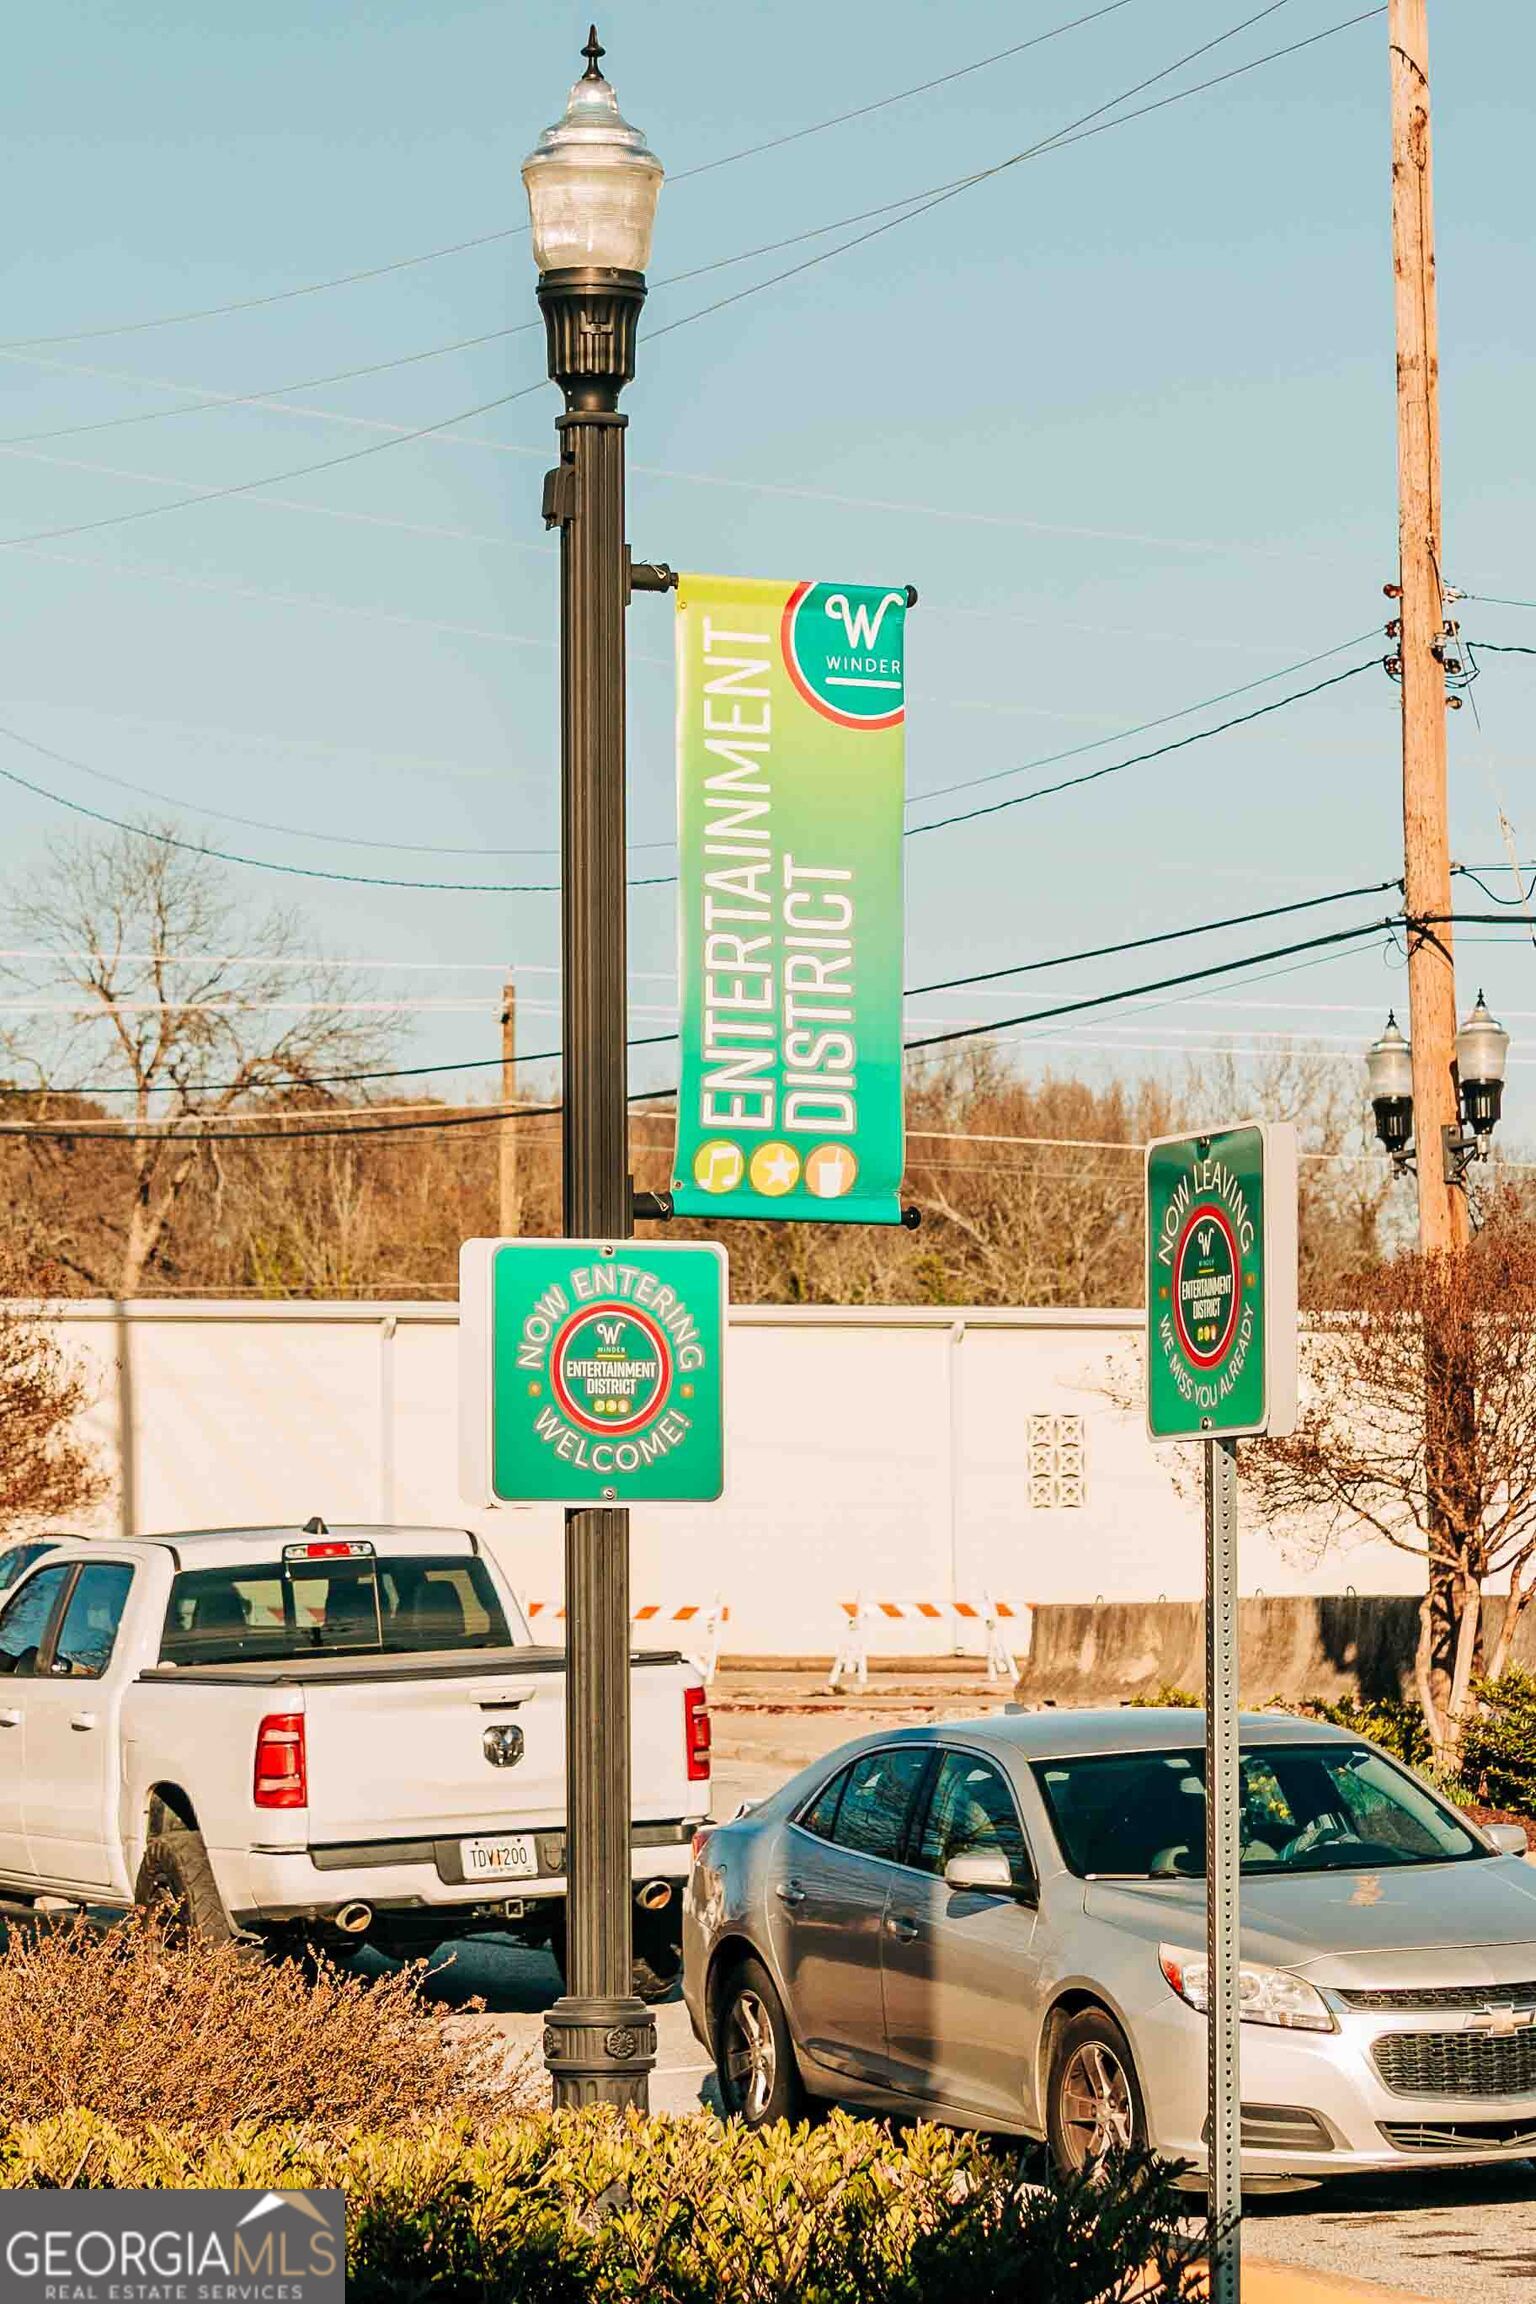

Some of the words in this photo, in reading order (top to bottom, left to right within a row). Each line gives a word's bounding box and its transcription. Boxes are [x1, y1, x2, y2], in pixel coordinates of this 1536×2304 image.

[825, 594, 904, 650] W
[826, 655, 901, 675] WINDER
[702, 615, 773, 1128] ENTERTAINMENT
[783, 853, 854, 1132] DISTRICT
[1158, 1174, 1190, 1266] NOW
[1193, 1159, 1255, 1254] LEAVING
[1181, 1274, 1232, 1301] ENTERTAINMENT
[1192, 1297, 1222, 1320] DISTRICT
[517, 1285, 569, 1369] NOW
[571, 1264, 704, 1371] ENTERING
[596, 1322, 626, 1345] W
[566, 1361, 657, 1378] ENTERTAINMENT
[1160, 1313, 1174, 1357] WE
[1169, 1353, 1193, 1400] MISS
[1195, 1384, 1218, 1408] YOU
[1220, 1301, 1254, 1400] ALREADY
[586, 1378, 637, 1395] DISTRICT
[534, 1407, 692, 1472] WELCOME!
